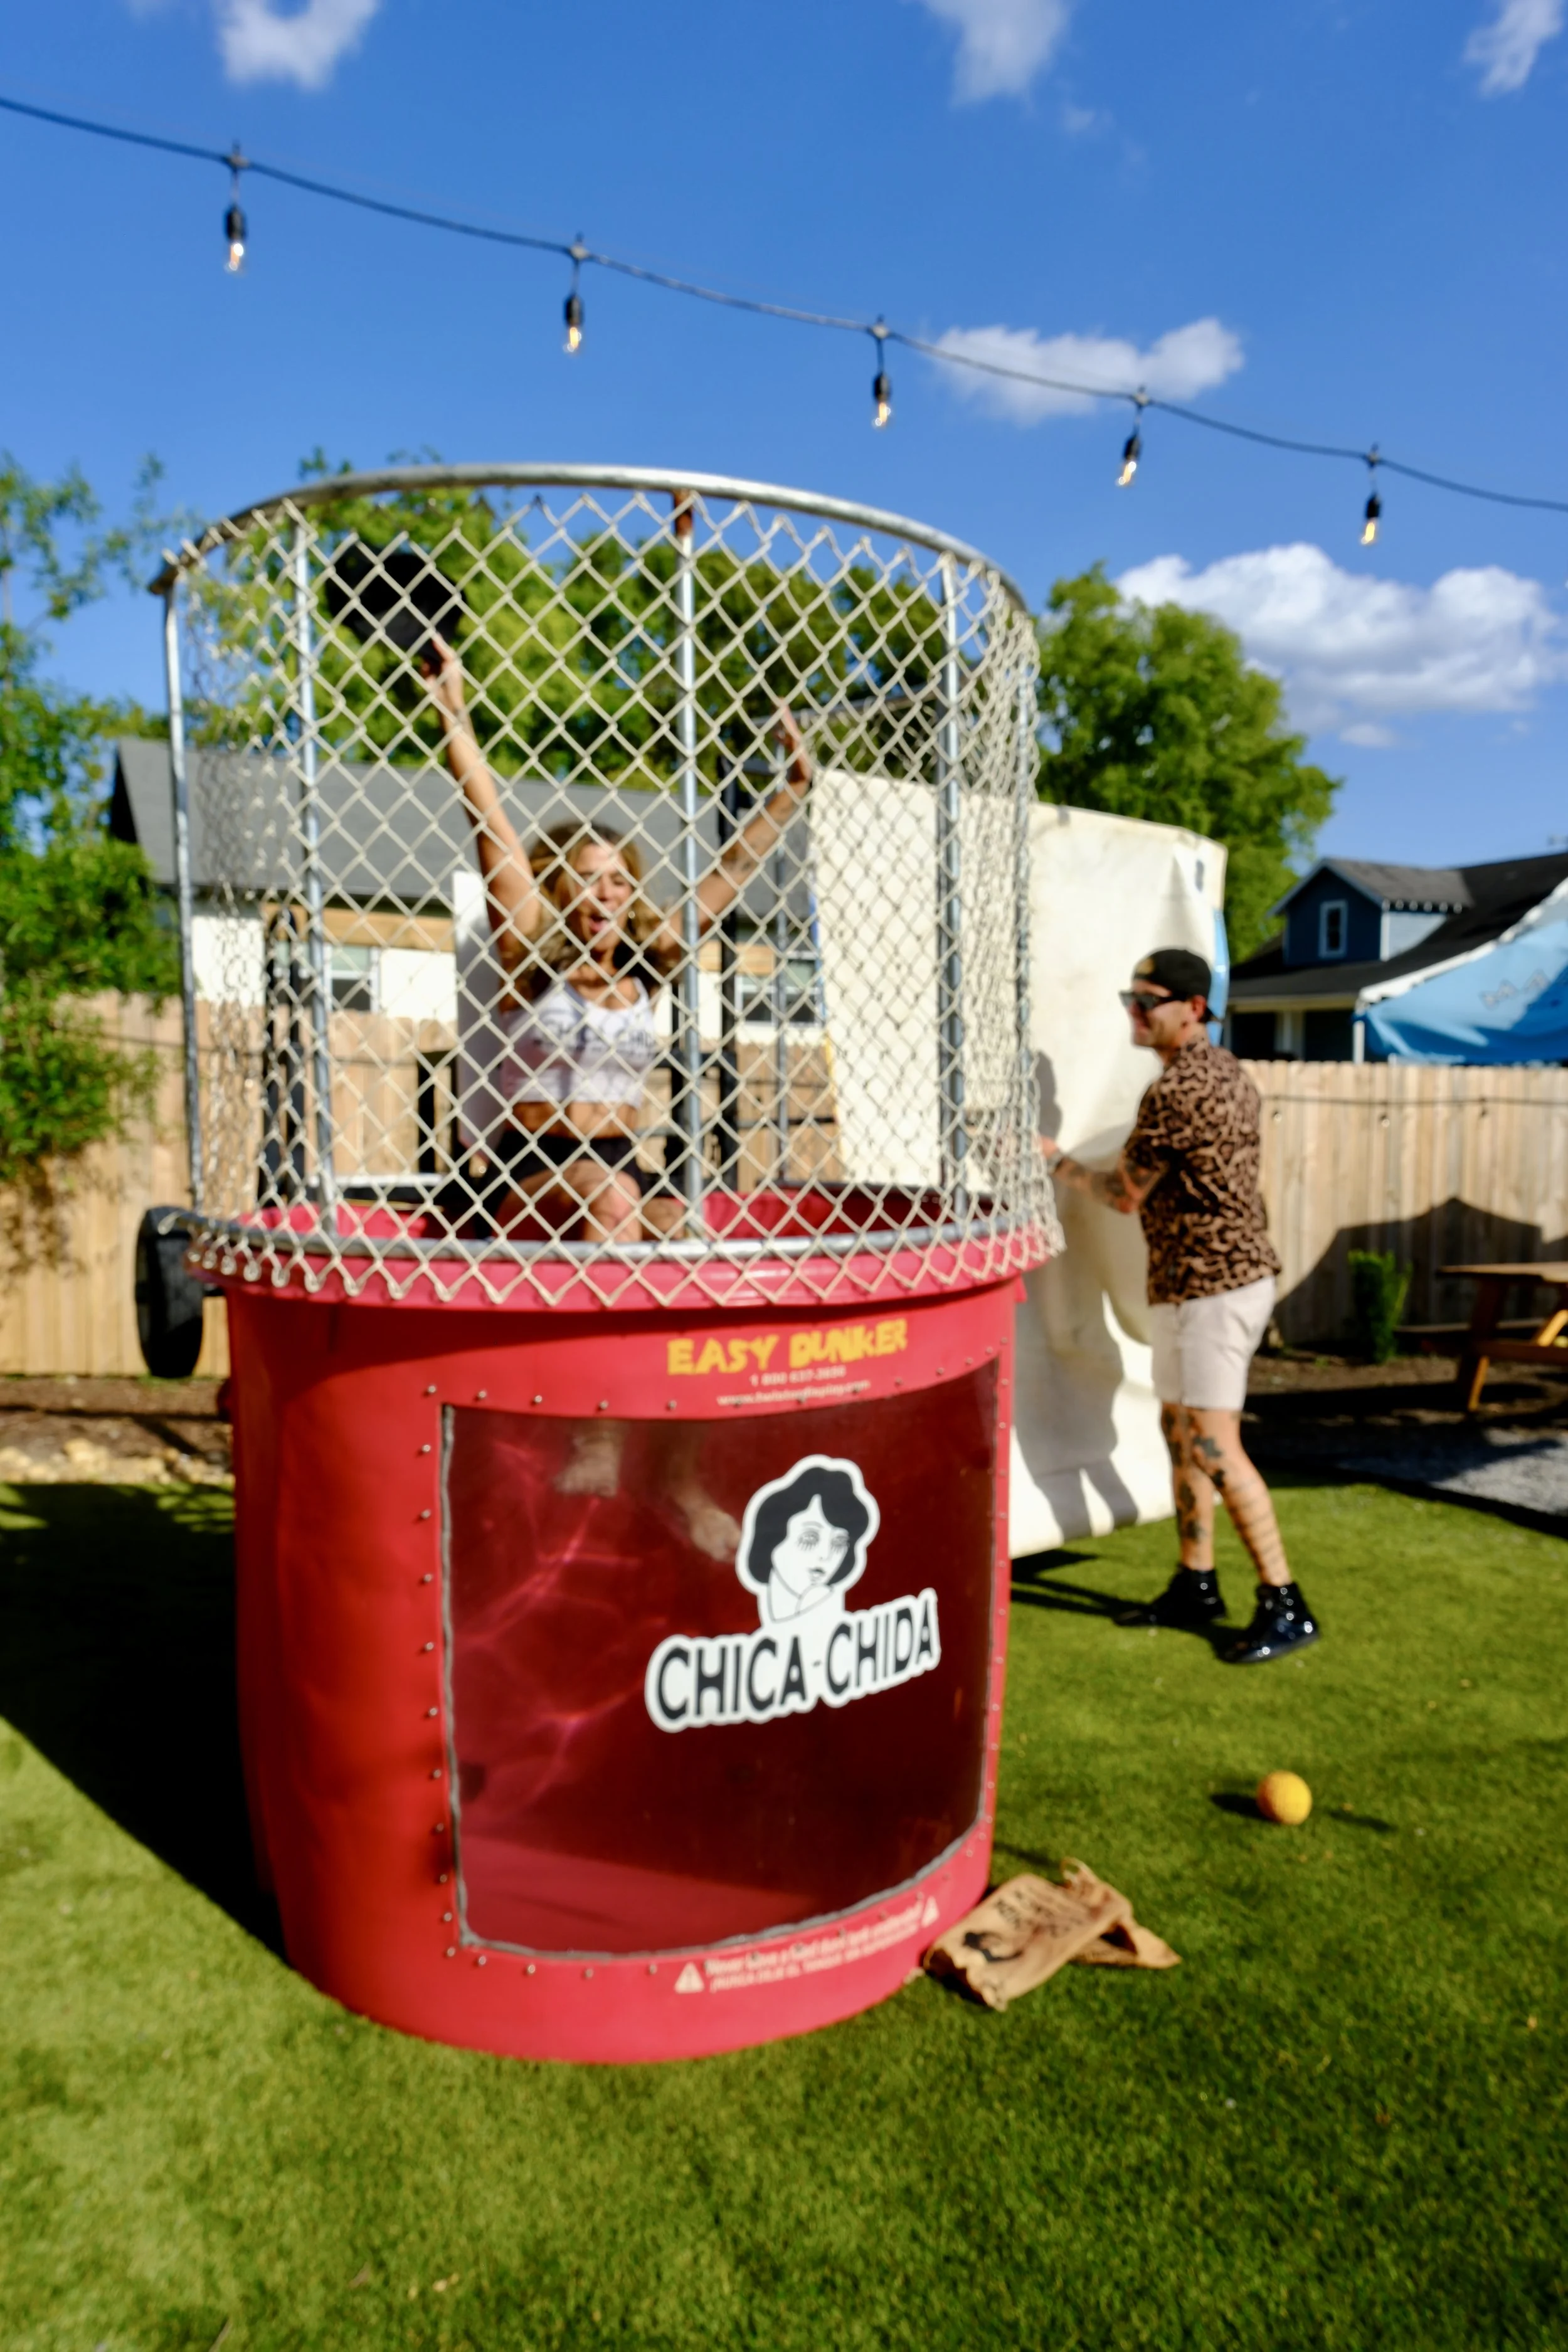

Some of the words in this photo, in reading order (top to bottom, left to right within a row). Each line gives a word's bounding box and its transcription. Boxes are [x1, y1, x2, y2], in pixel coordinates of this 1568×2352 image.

[667, 1334, 780, 1375] EASY
[789, 1318, 908, 1369] DUNKER
[658, 1599, 933, 1720] CHICA-CHIDA
